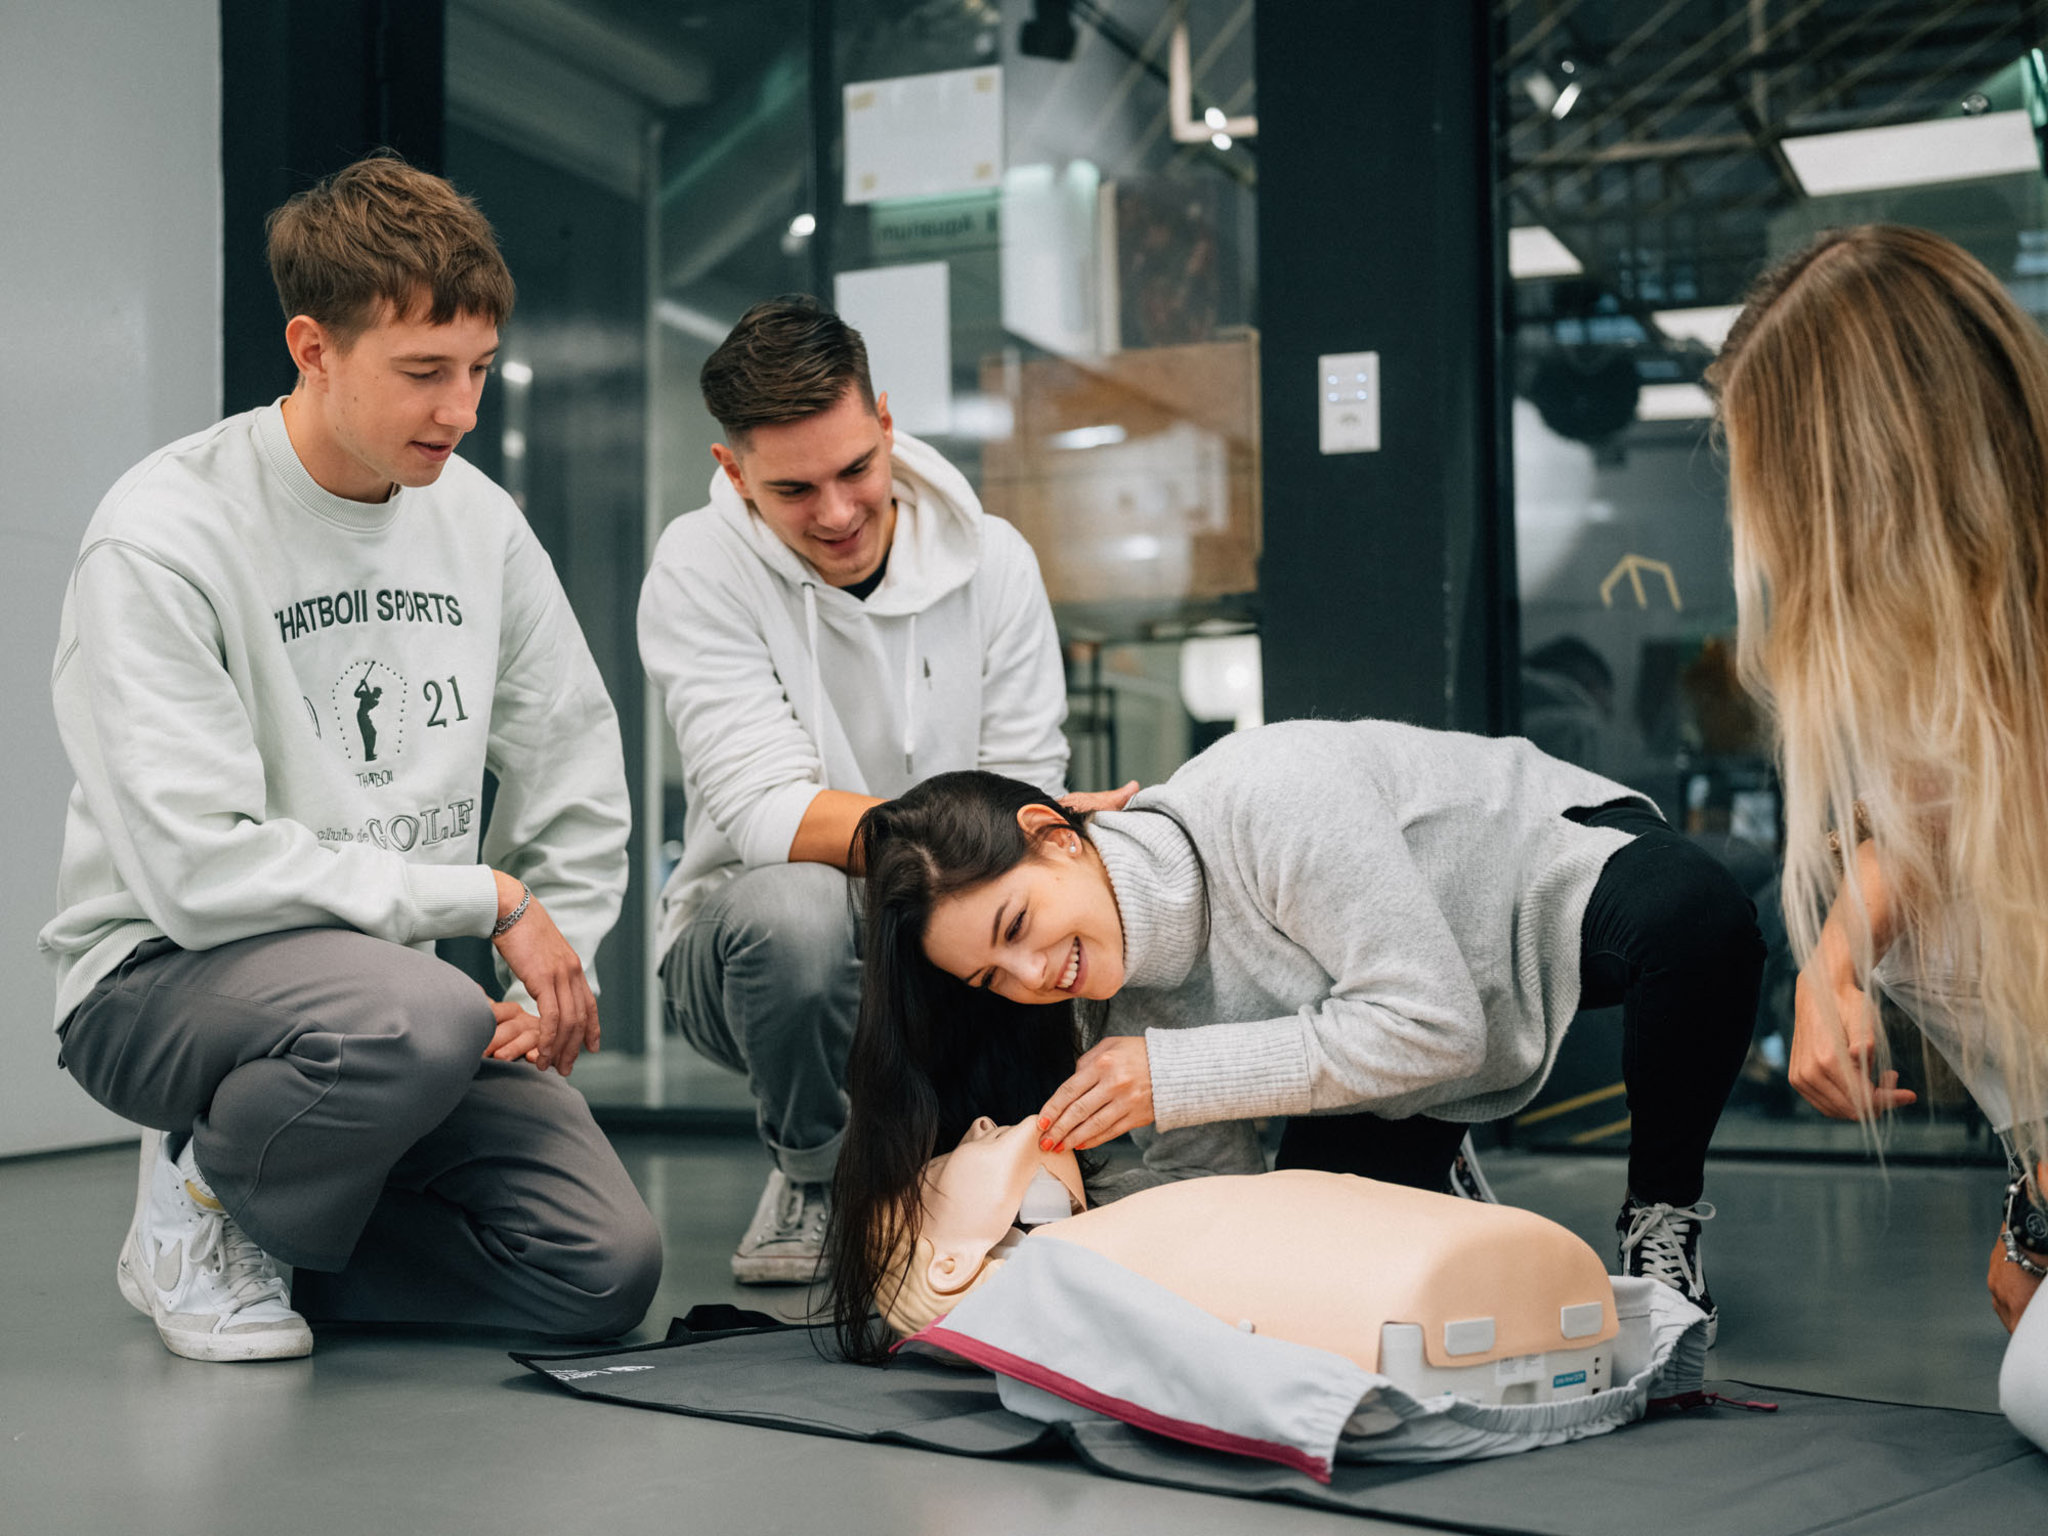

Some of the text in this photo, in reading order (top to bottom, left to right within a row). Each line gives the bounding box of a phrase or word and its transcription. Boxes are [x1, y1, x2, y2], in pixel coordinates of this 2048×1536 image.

[274, 589, 463, 643] HATBOII SPORTS
[423, 675, 468, 727] 21
[366, 799, 474, 852] GOLF
